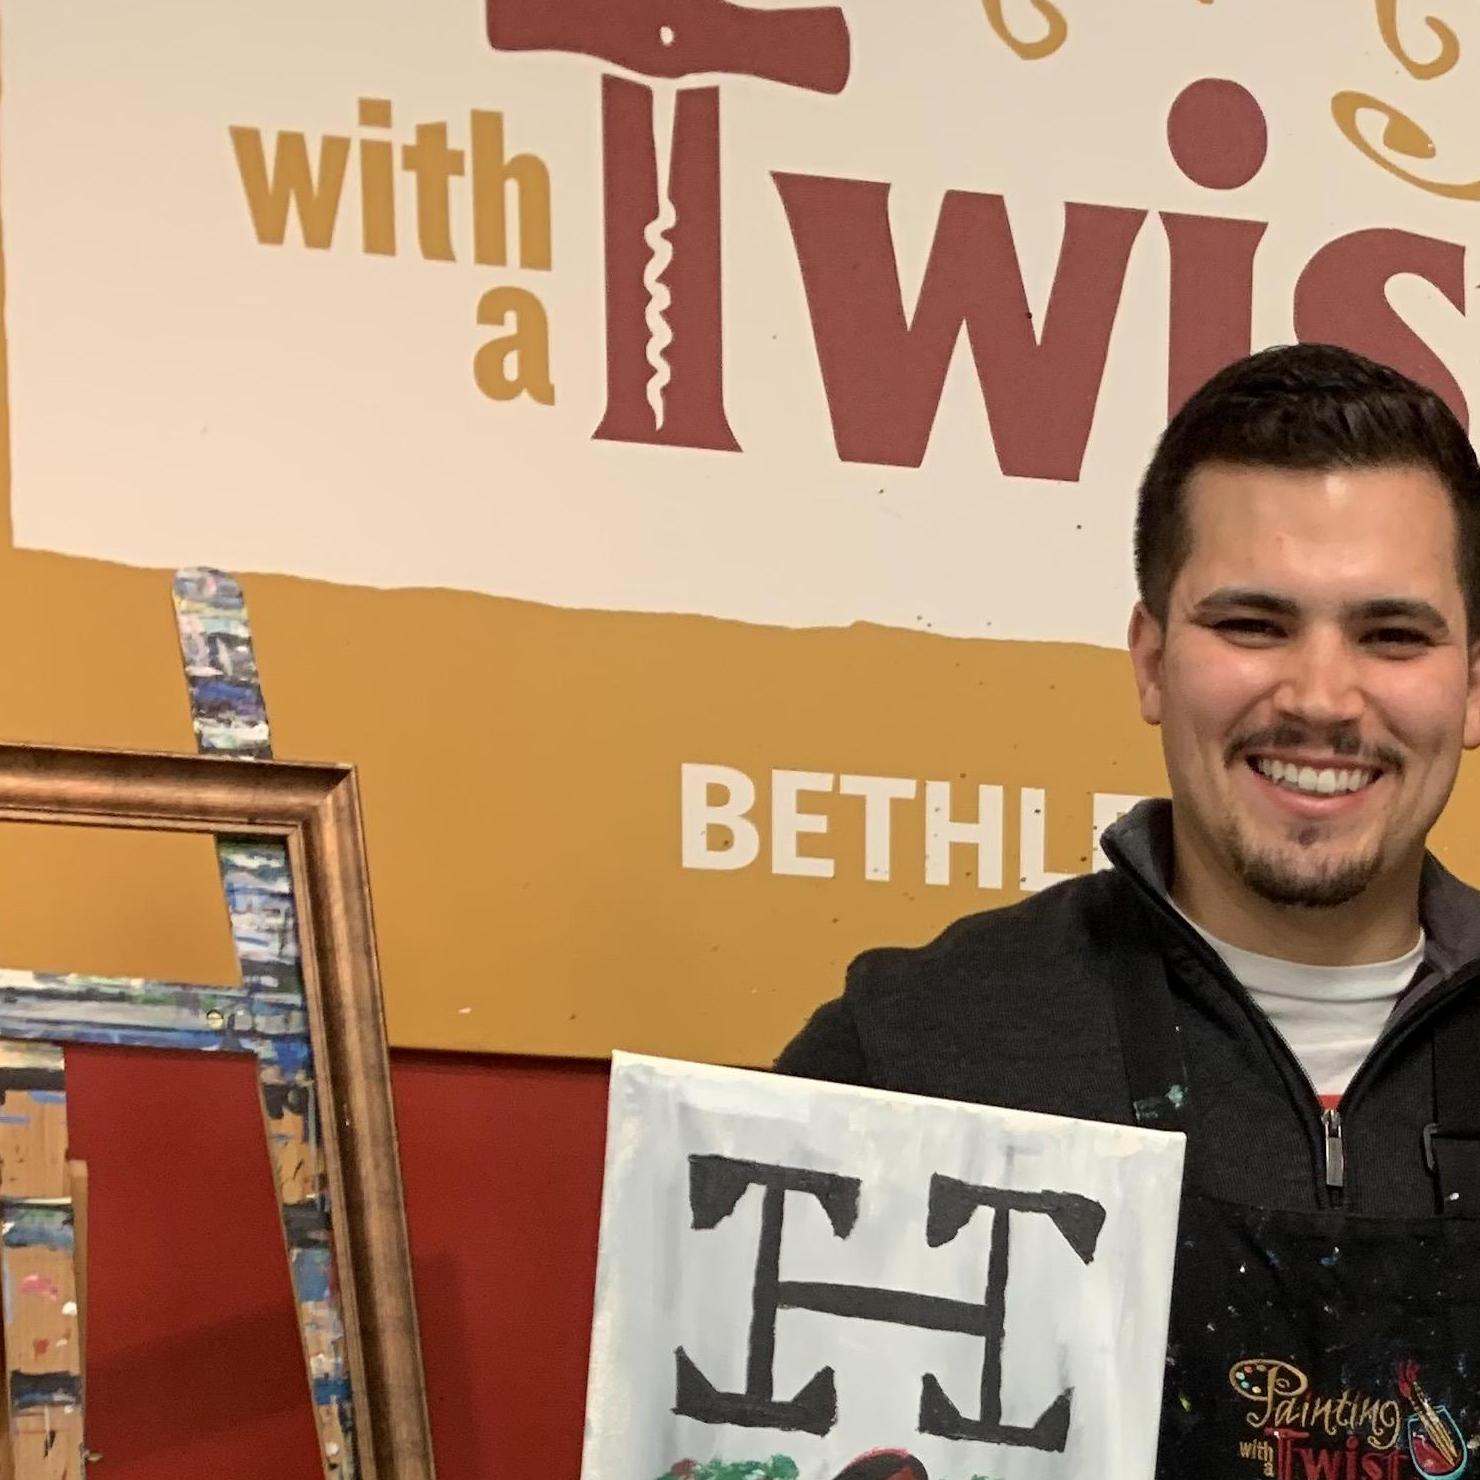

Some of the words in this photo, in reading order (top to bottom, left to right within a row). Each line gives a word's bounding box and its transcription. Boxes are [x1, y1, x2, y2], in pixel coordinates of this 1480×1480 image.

[228, 96, 553, 272] with
[473, 285, 556, 407] a
[1228, 1358, 1401, 1450] Painting
[1238, 1438, 1275, 1462] with
